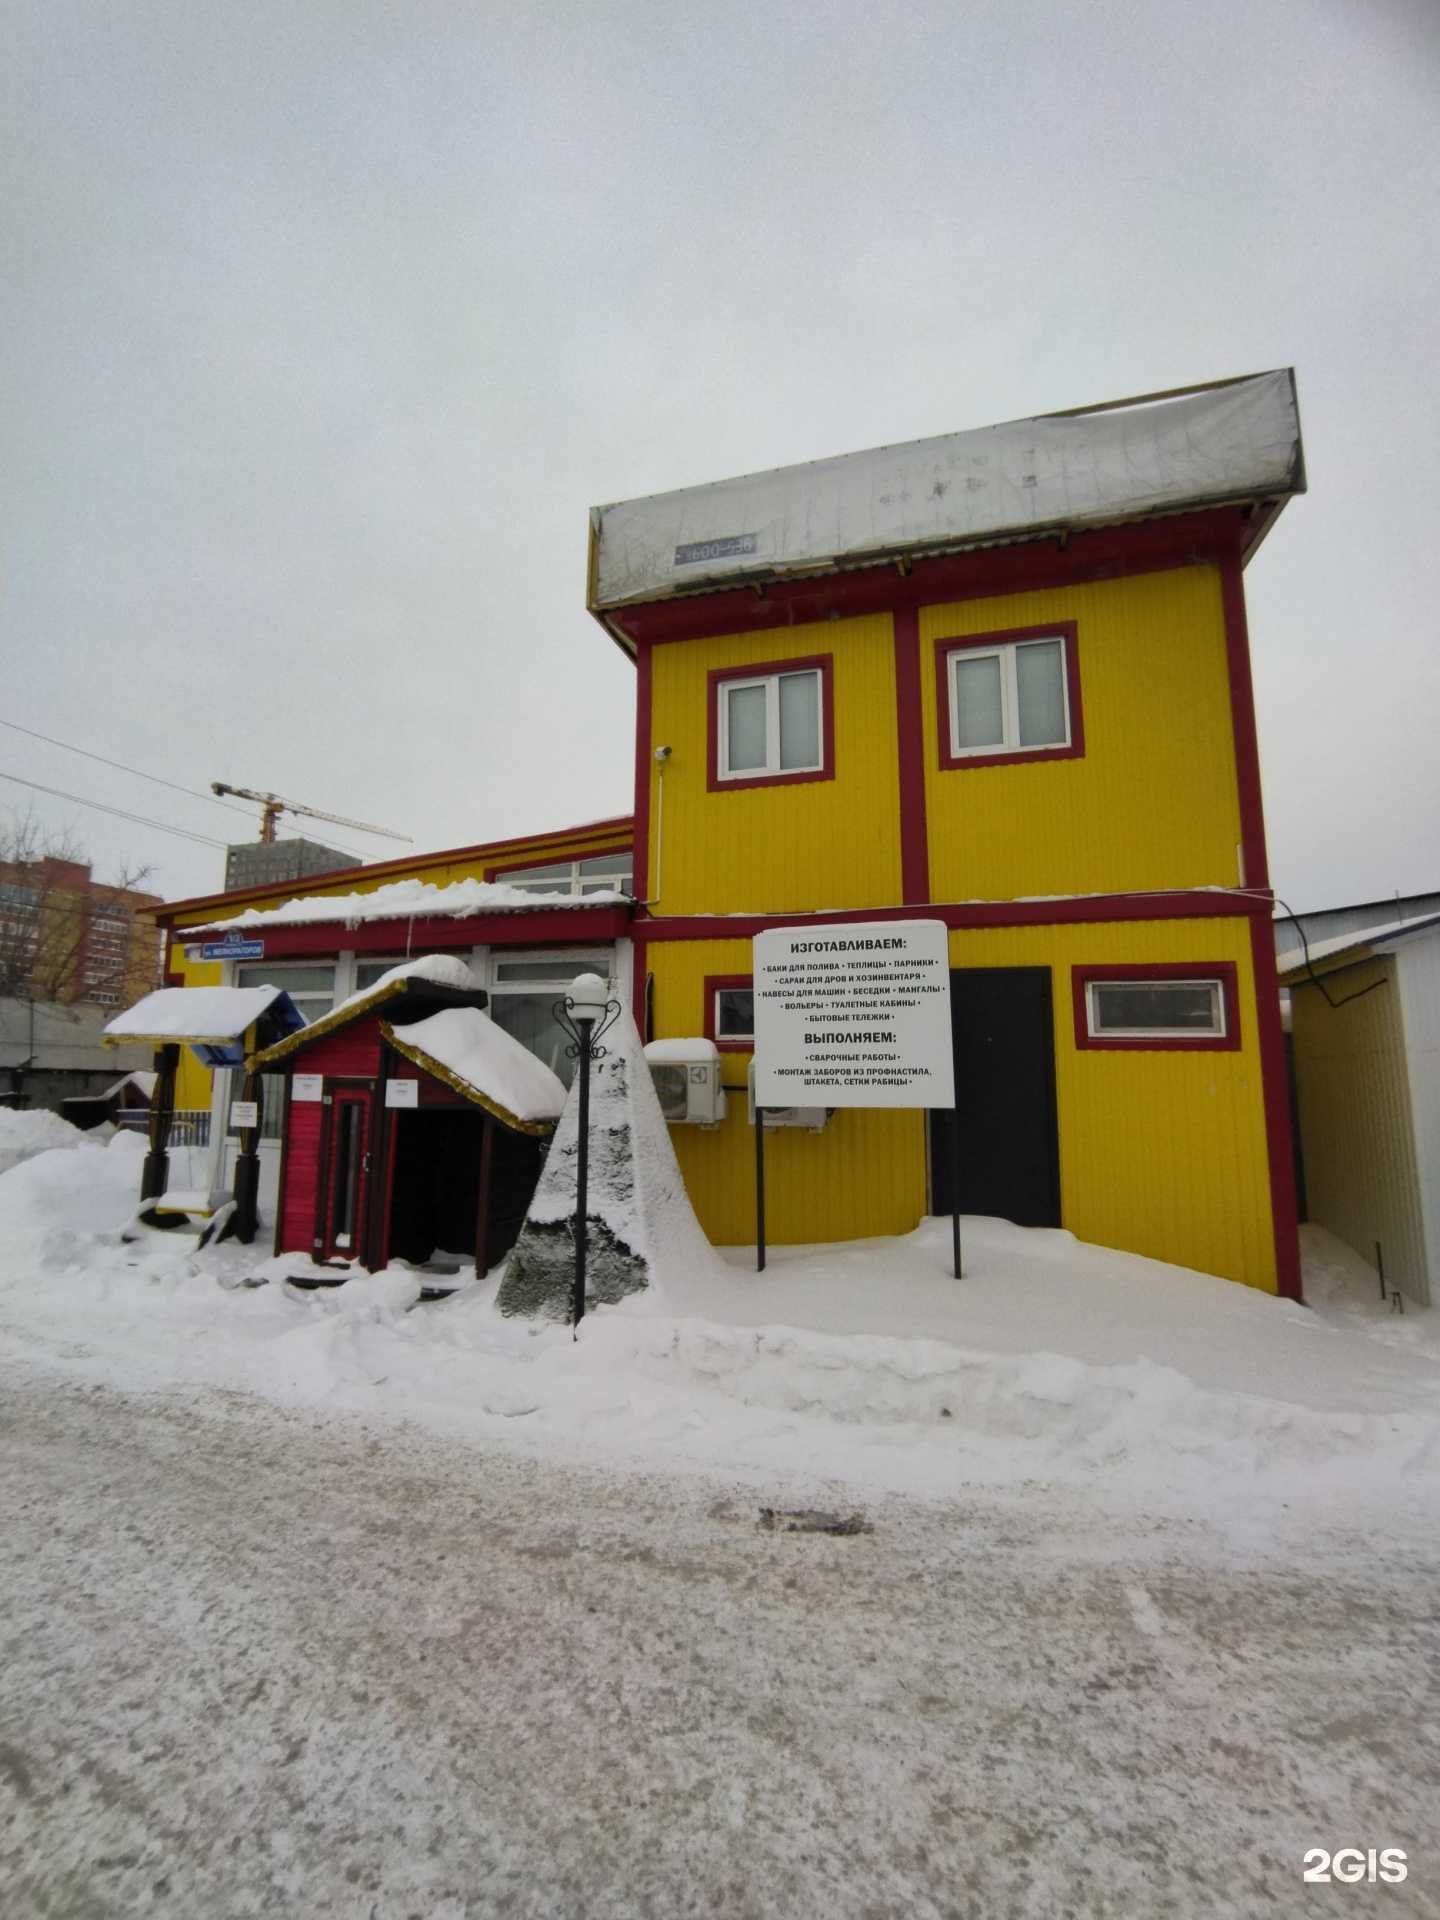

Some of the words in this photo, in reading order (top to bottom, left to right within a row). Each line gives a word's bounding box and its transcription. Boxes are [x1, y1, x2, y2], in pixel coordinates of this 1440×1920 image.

[791, 938, 907, 953] ИЗГОТАВЛИВАЕМ:
[767, 965, 787, 973] БАКИ
[847, 961, 886, 969] ТЕПЛИЦЫ
[806, 976, 823, 984] ДЛЯ
[762, 990, 794, 998] НАВЕСЫ
[853, 987, 890, 995] БЕСЕДКИ
[785, 1002, 824, 1010] ВОЛЬЕРЫ
[805, 1032, 896, 1044] ВЫПОЛНЯЕМ:
[867, 1068, 932, 1076] ПРОФНАСТИЛА,
[872, 1078, 907, 1086] РАБИЦЫ
